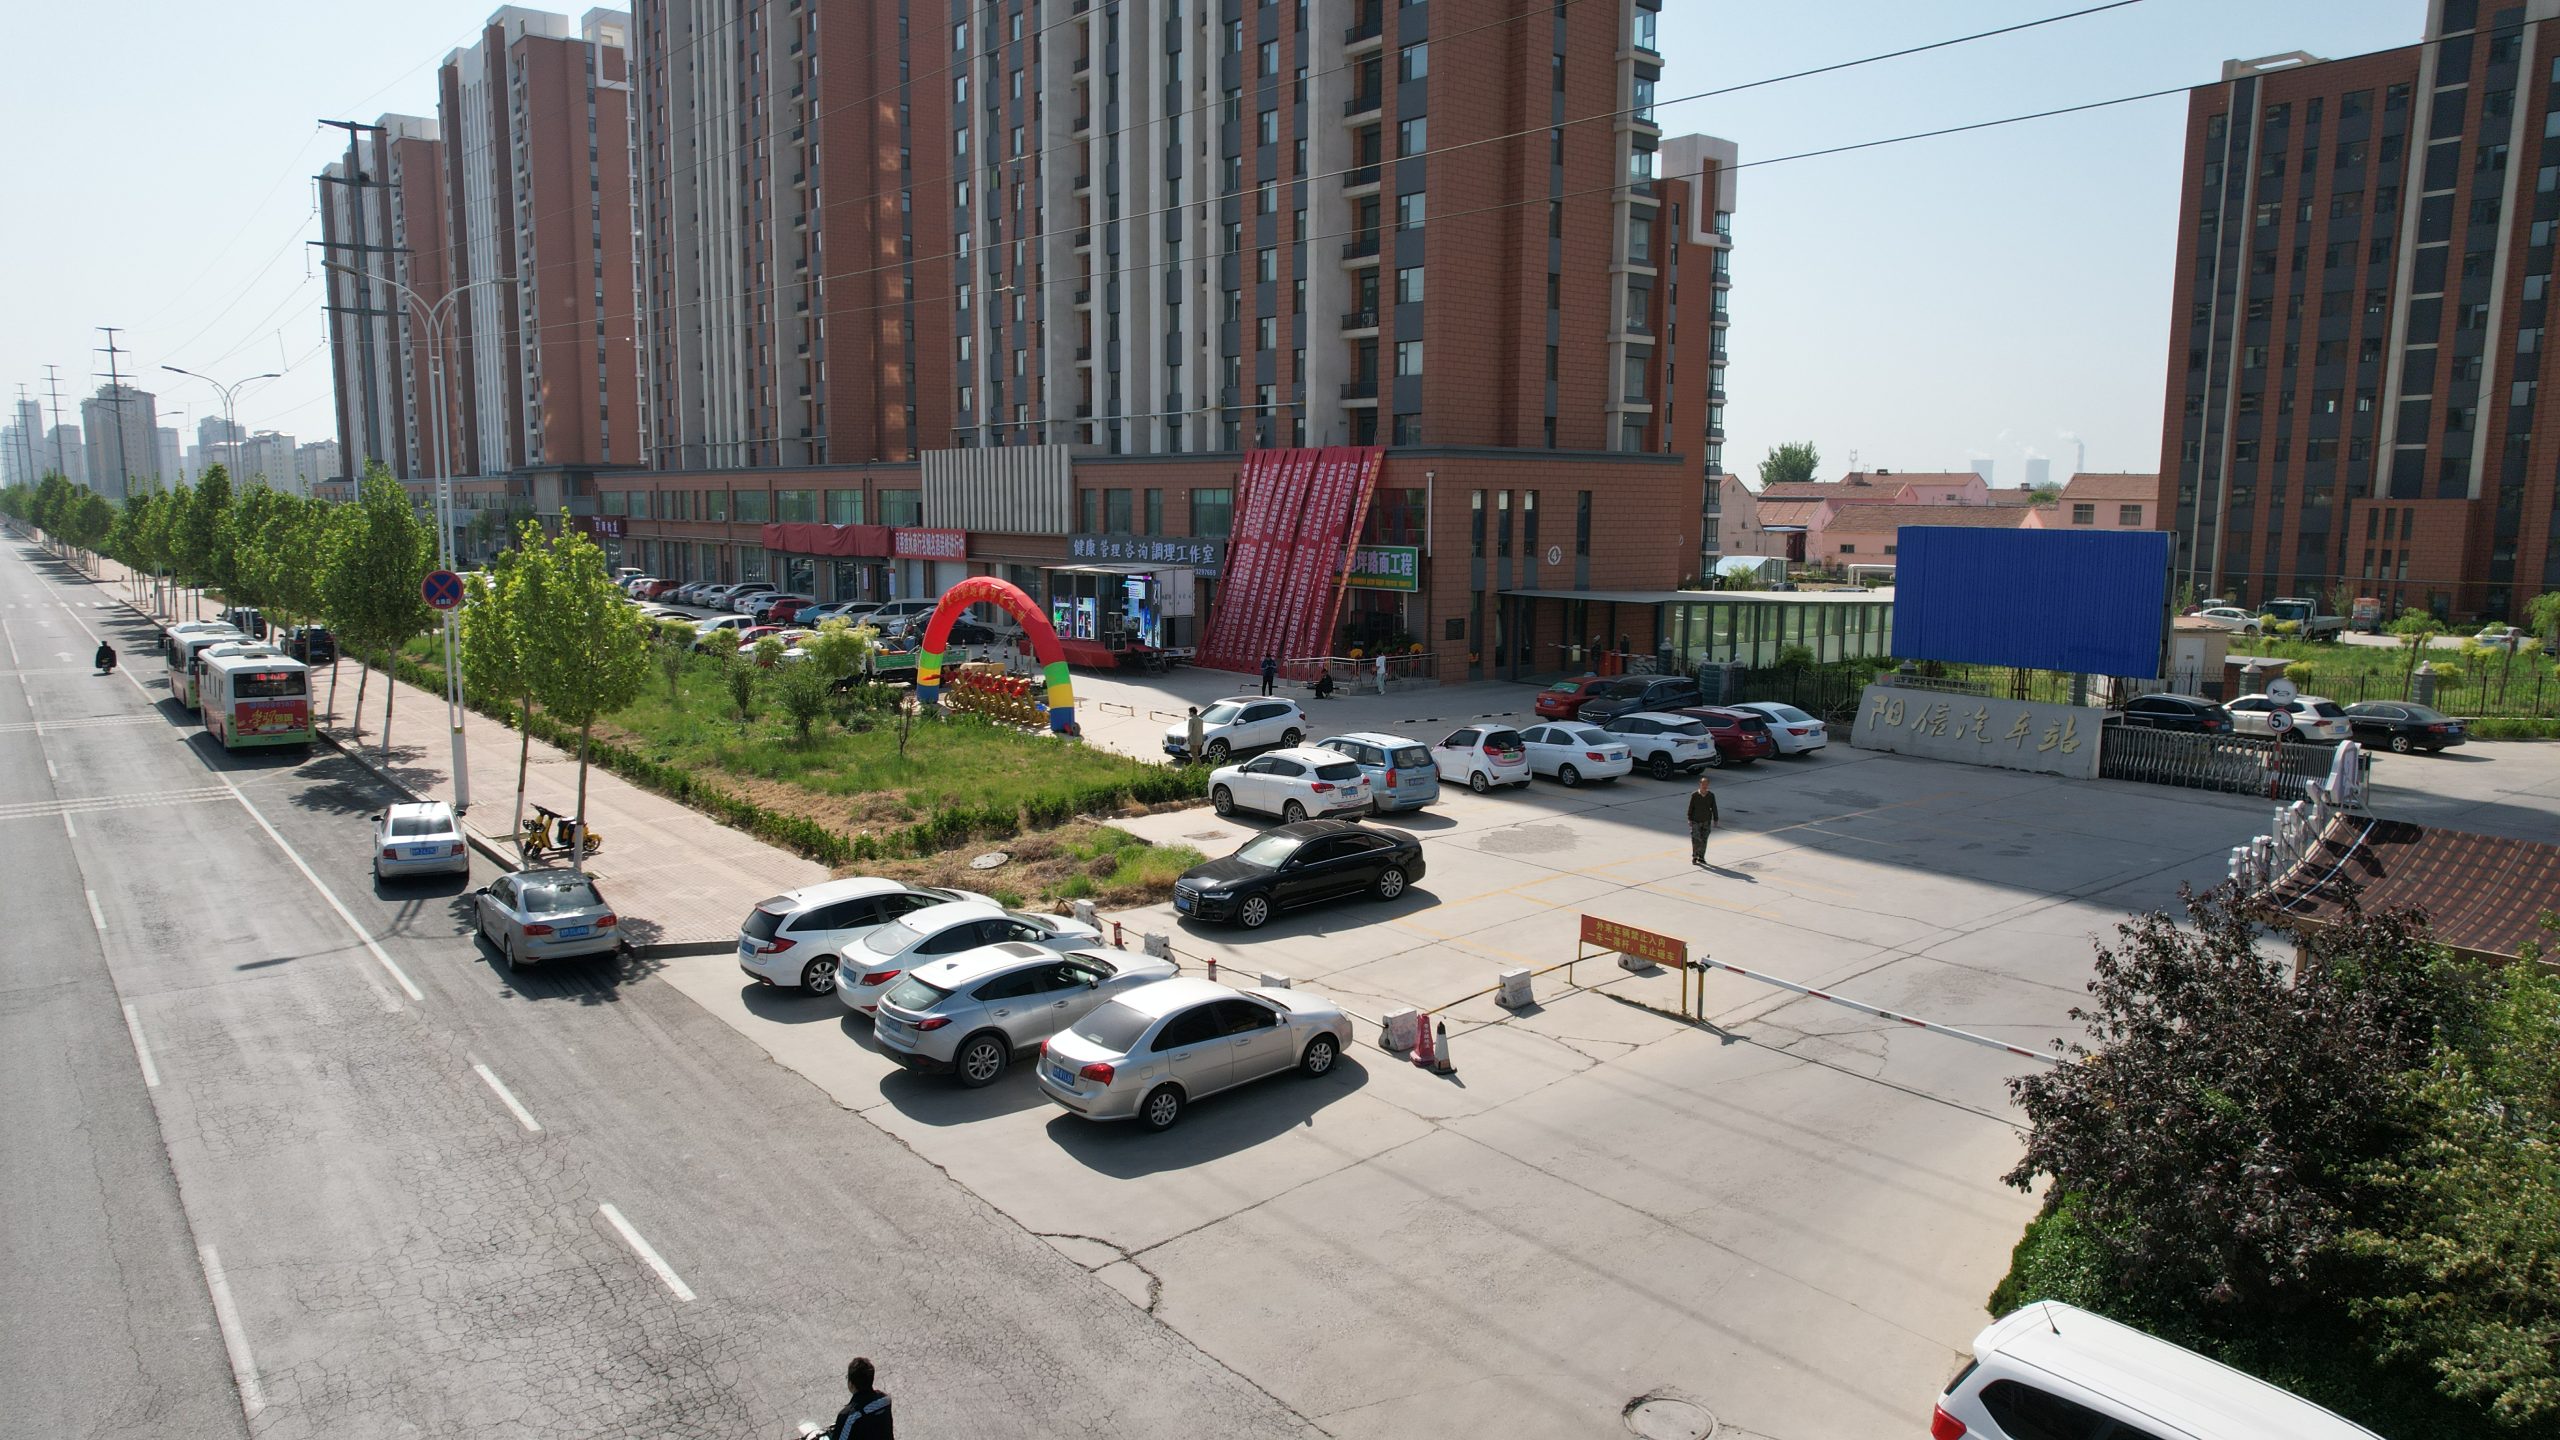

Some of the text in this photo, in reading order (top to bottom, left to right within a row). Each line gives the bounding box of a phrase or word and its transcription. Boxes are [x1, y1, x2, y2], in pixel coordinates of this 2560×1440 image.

[1868, 694, 2082, 755] 阳信汽车站
[2271, 713, 2282, 728] 5
[1596, 921, 1666, 948] 外来车辆禁止入内
